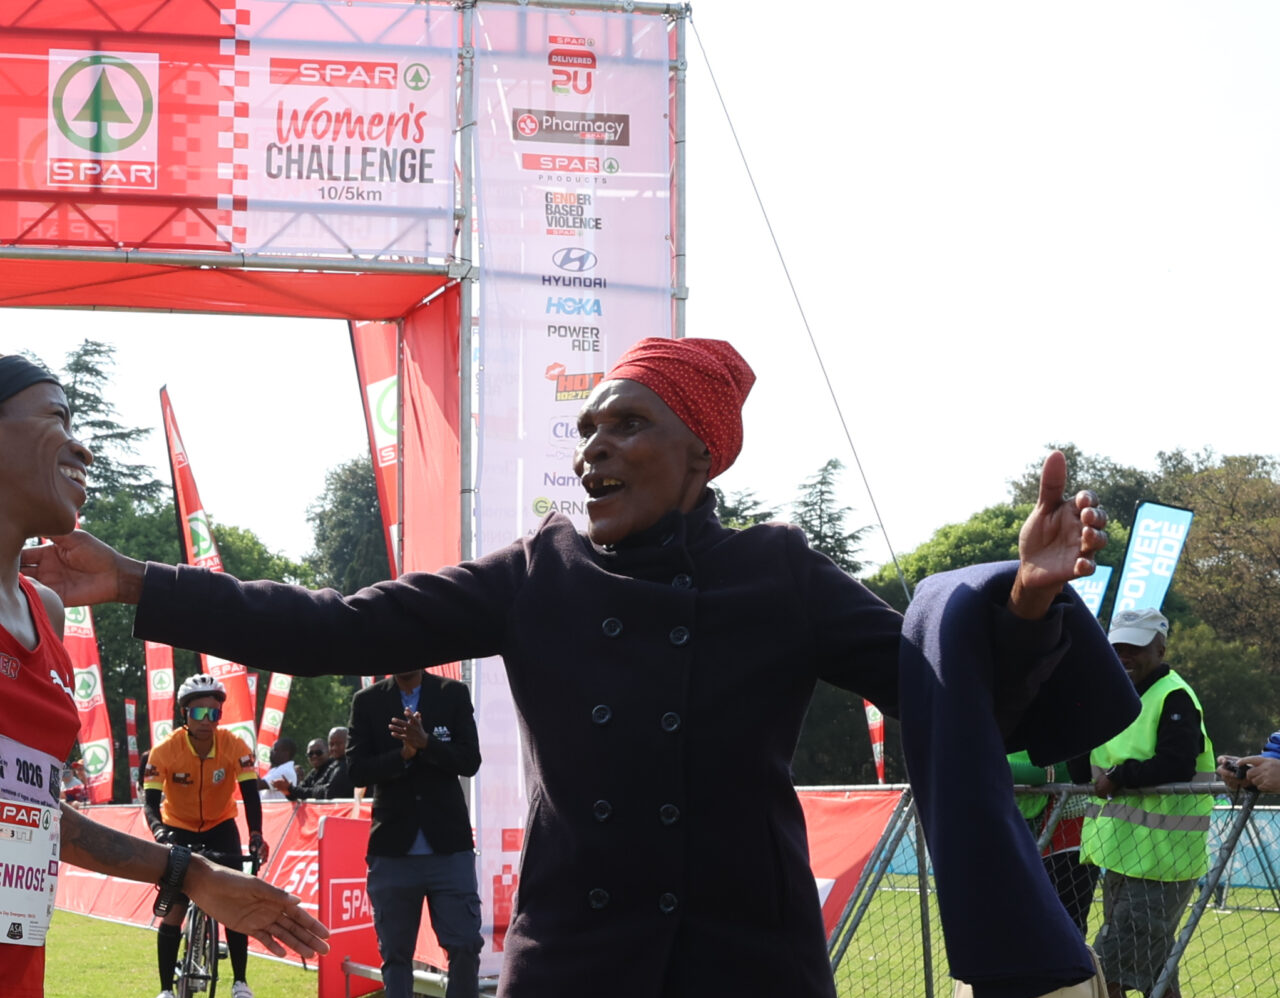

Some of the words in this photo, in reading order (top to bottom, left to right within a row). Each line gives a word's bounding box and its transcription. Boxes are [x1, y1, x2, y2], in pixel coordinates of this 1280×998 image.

[557, 37, 585, 45] SPAR
[551, 55, 593, 65] DELIVERED
[300, 63, 395, 85] SPAR
[551, 69, 592, 94] 2U
[276, 97, 427, 147] Women's
[542, 116, 624, 141] Pharmacy
[265, 142, 435, 184] CHALLENGE
[539, 157, 600, 171] SPAR
[52, 162, 152, 183] SPAR
[538, 175, 608, 184] PRODUCTS
[318, 186, 383, 202] 10/5km
[545, 192, 591, 206] GENDER
[545, 204, 584, 217] BASED
[546, 215, 602, 230] VIOLENCE
[542, 275, 607, 288] HYUNDAI
[545, 296, 603, 317] HOKA
[547, 324, 600, 339] POWER
[571, 339, 600, 352] ADE
[558, 372, 604, 391] HOT
[553, 422, 580, 438] Cle
[544, 472, 581, 487] Nam
[535, 500, 589, 516] GARNI
[1152, 521, 1185, 577] ADE
[1118, 518, 1163, 612] POWER
[16, 758, 43, 789] 2026
[284, 862, 319, 896] SP
[10, 924, 22, 933] ASA
